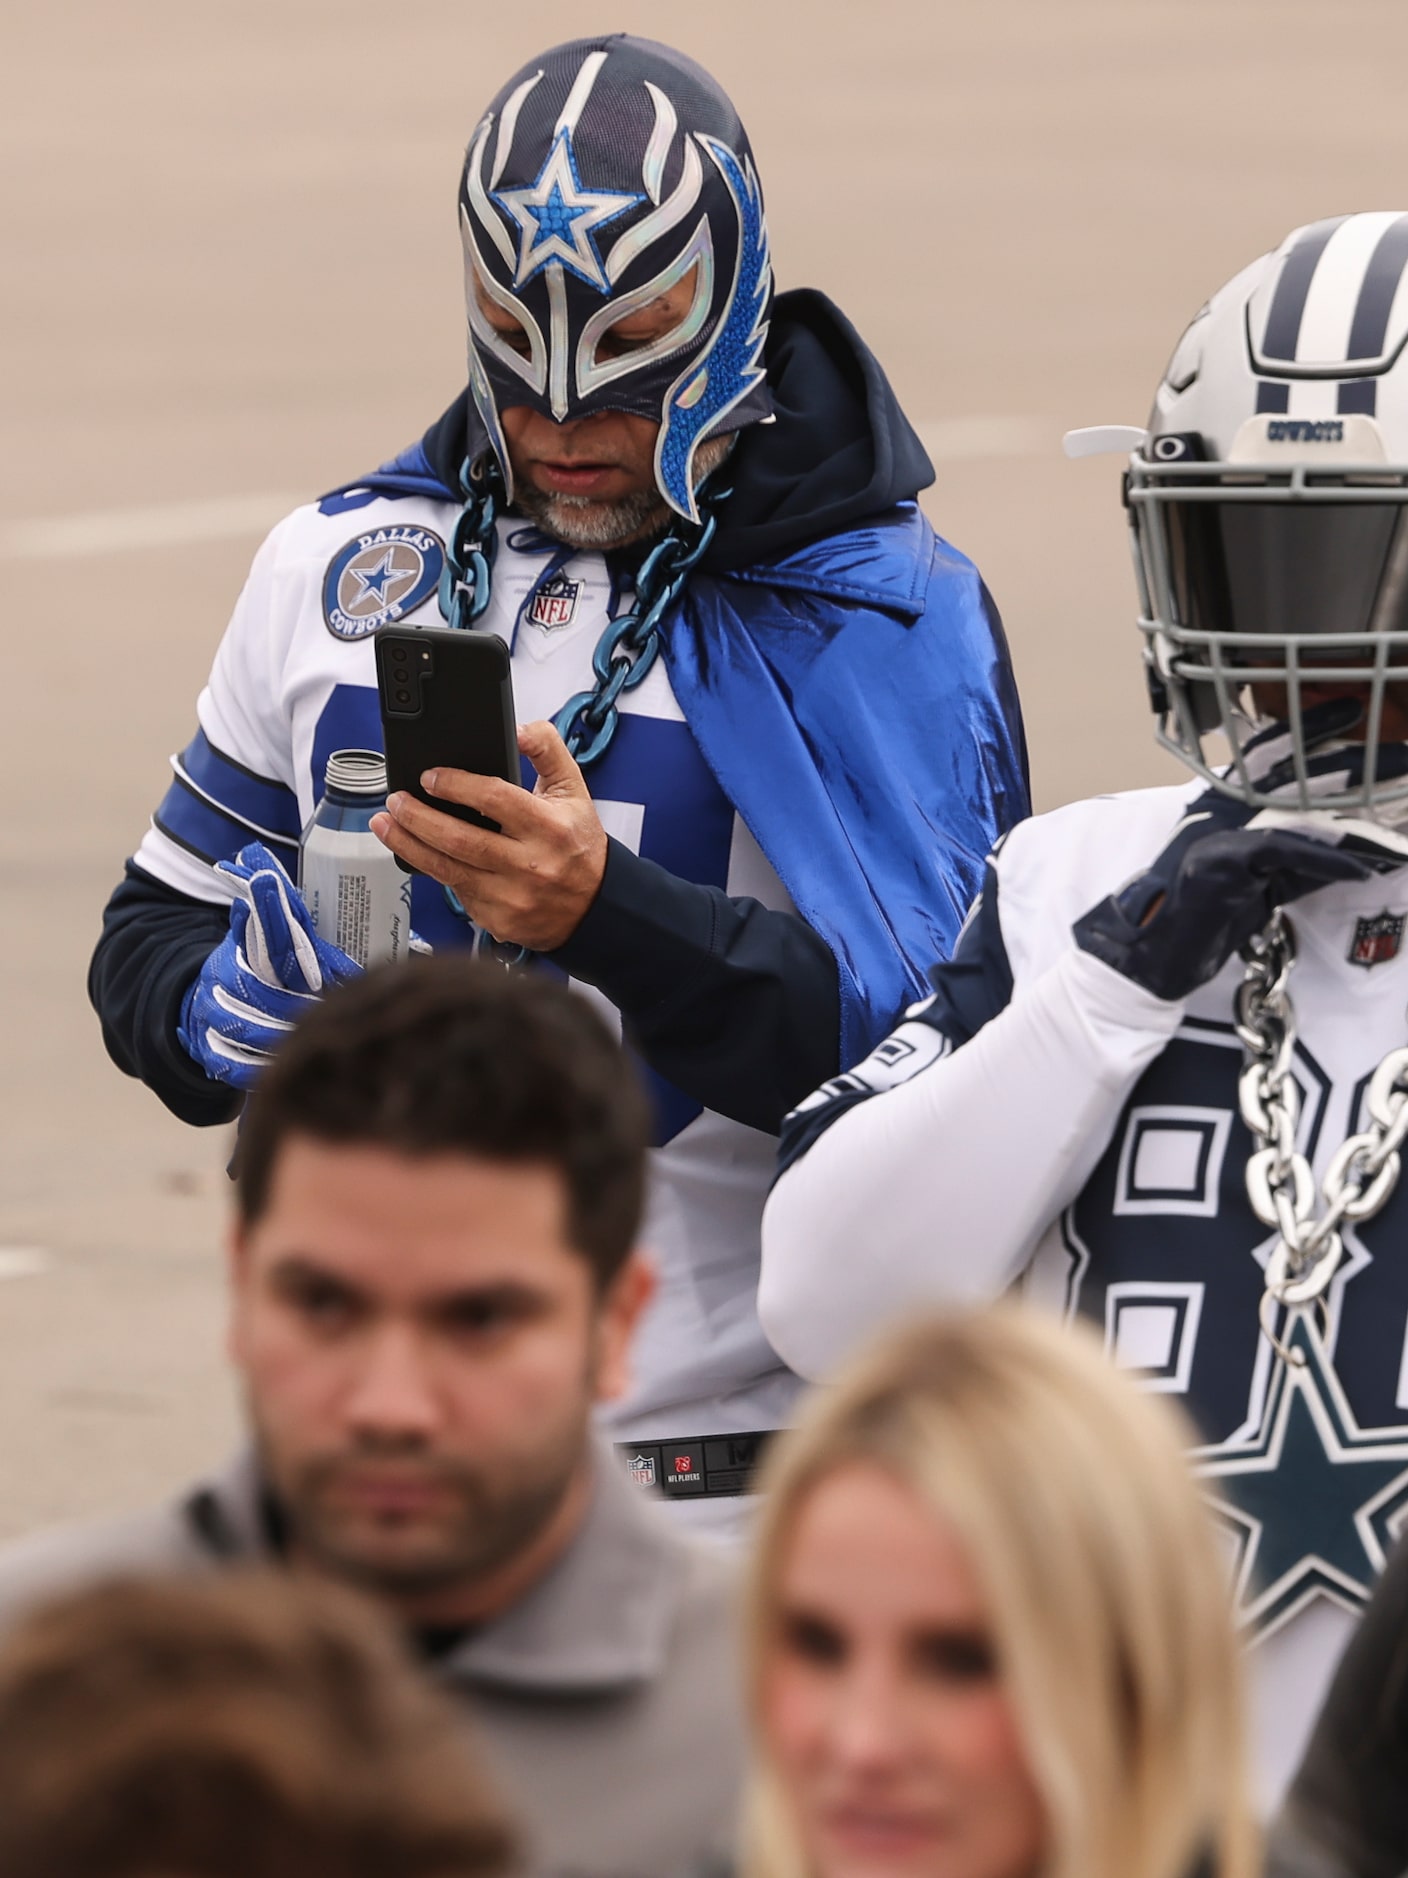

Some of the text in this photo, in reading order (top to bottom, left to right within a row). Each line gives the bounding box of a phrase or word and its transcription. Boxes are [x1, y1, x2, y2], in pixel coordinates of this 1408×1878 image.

[358, 527, 435, 552] DALLAS
[329, 604, 403, 634] COWBOYS
[532, 597, 569, 622] NFL
[386, 912, 401, 966] uengling
[631, 1470, 653, 1484] NFL
[667, 1475, 678, 1483] NFL
[678, 1472, 701, 1482] PLAYERS
